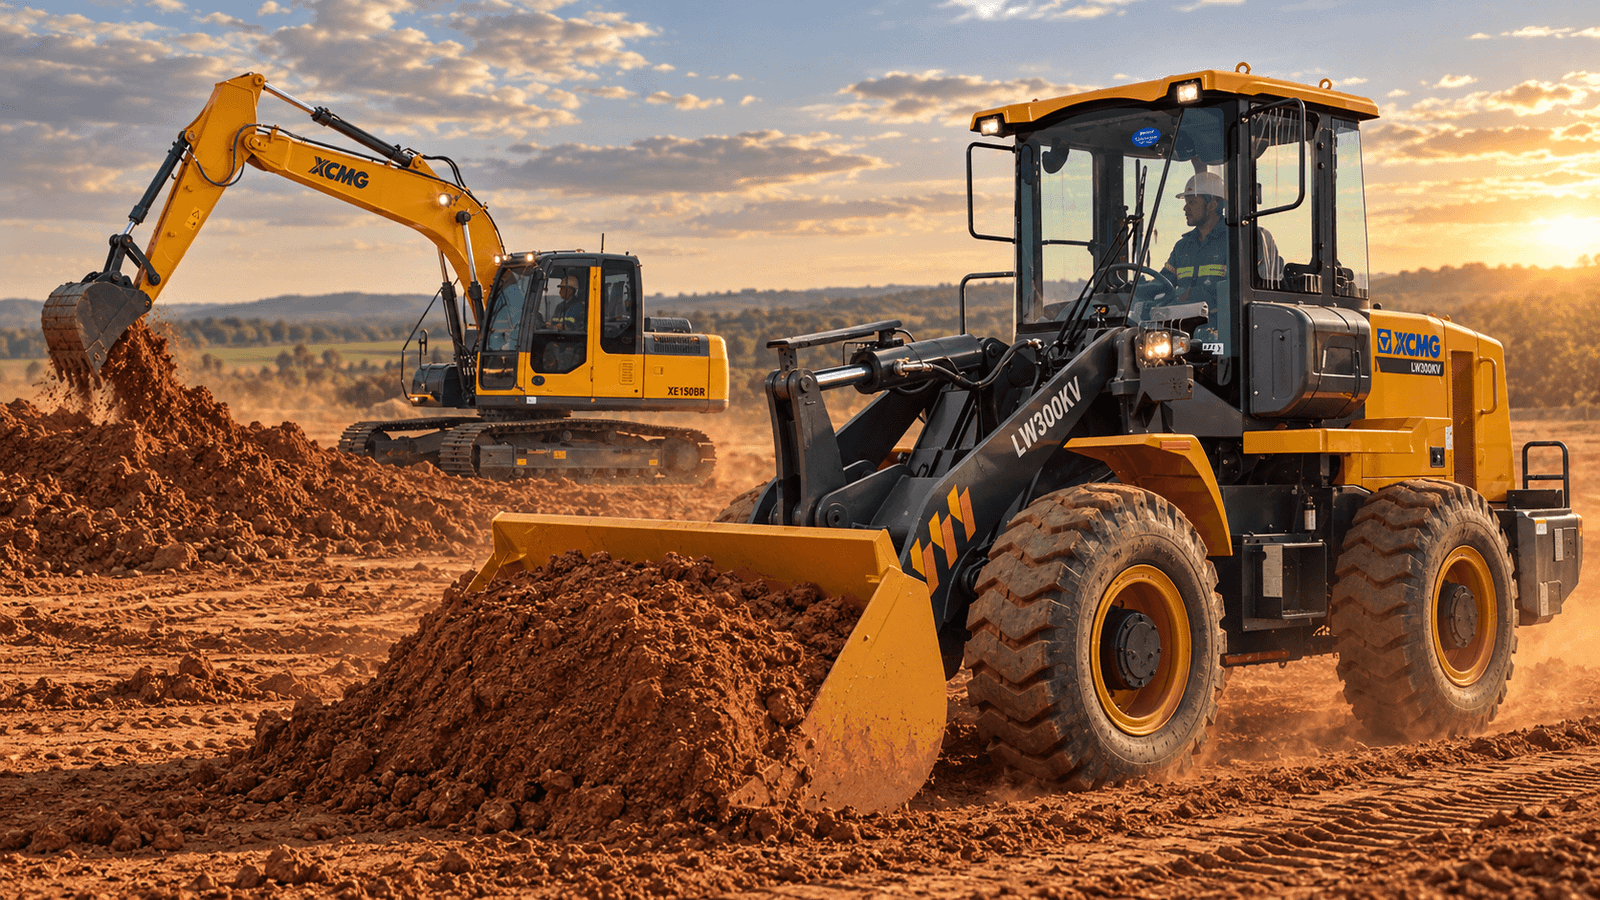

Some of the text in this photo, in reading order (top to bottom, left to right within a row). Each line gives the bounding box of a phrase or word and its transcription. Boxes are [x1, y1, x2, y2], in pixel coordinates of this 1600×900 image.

[308, 156, 369, 189] XCMG
[1393, 332, 1440, 359] XCMG
[1410, 362, 1441, 375] LW300KV
[1010, 375, 1082, 458] LW300KV
